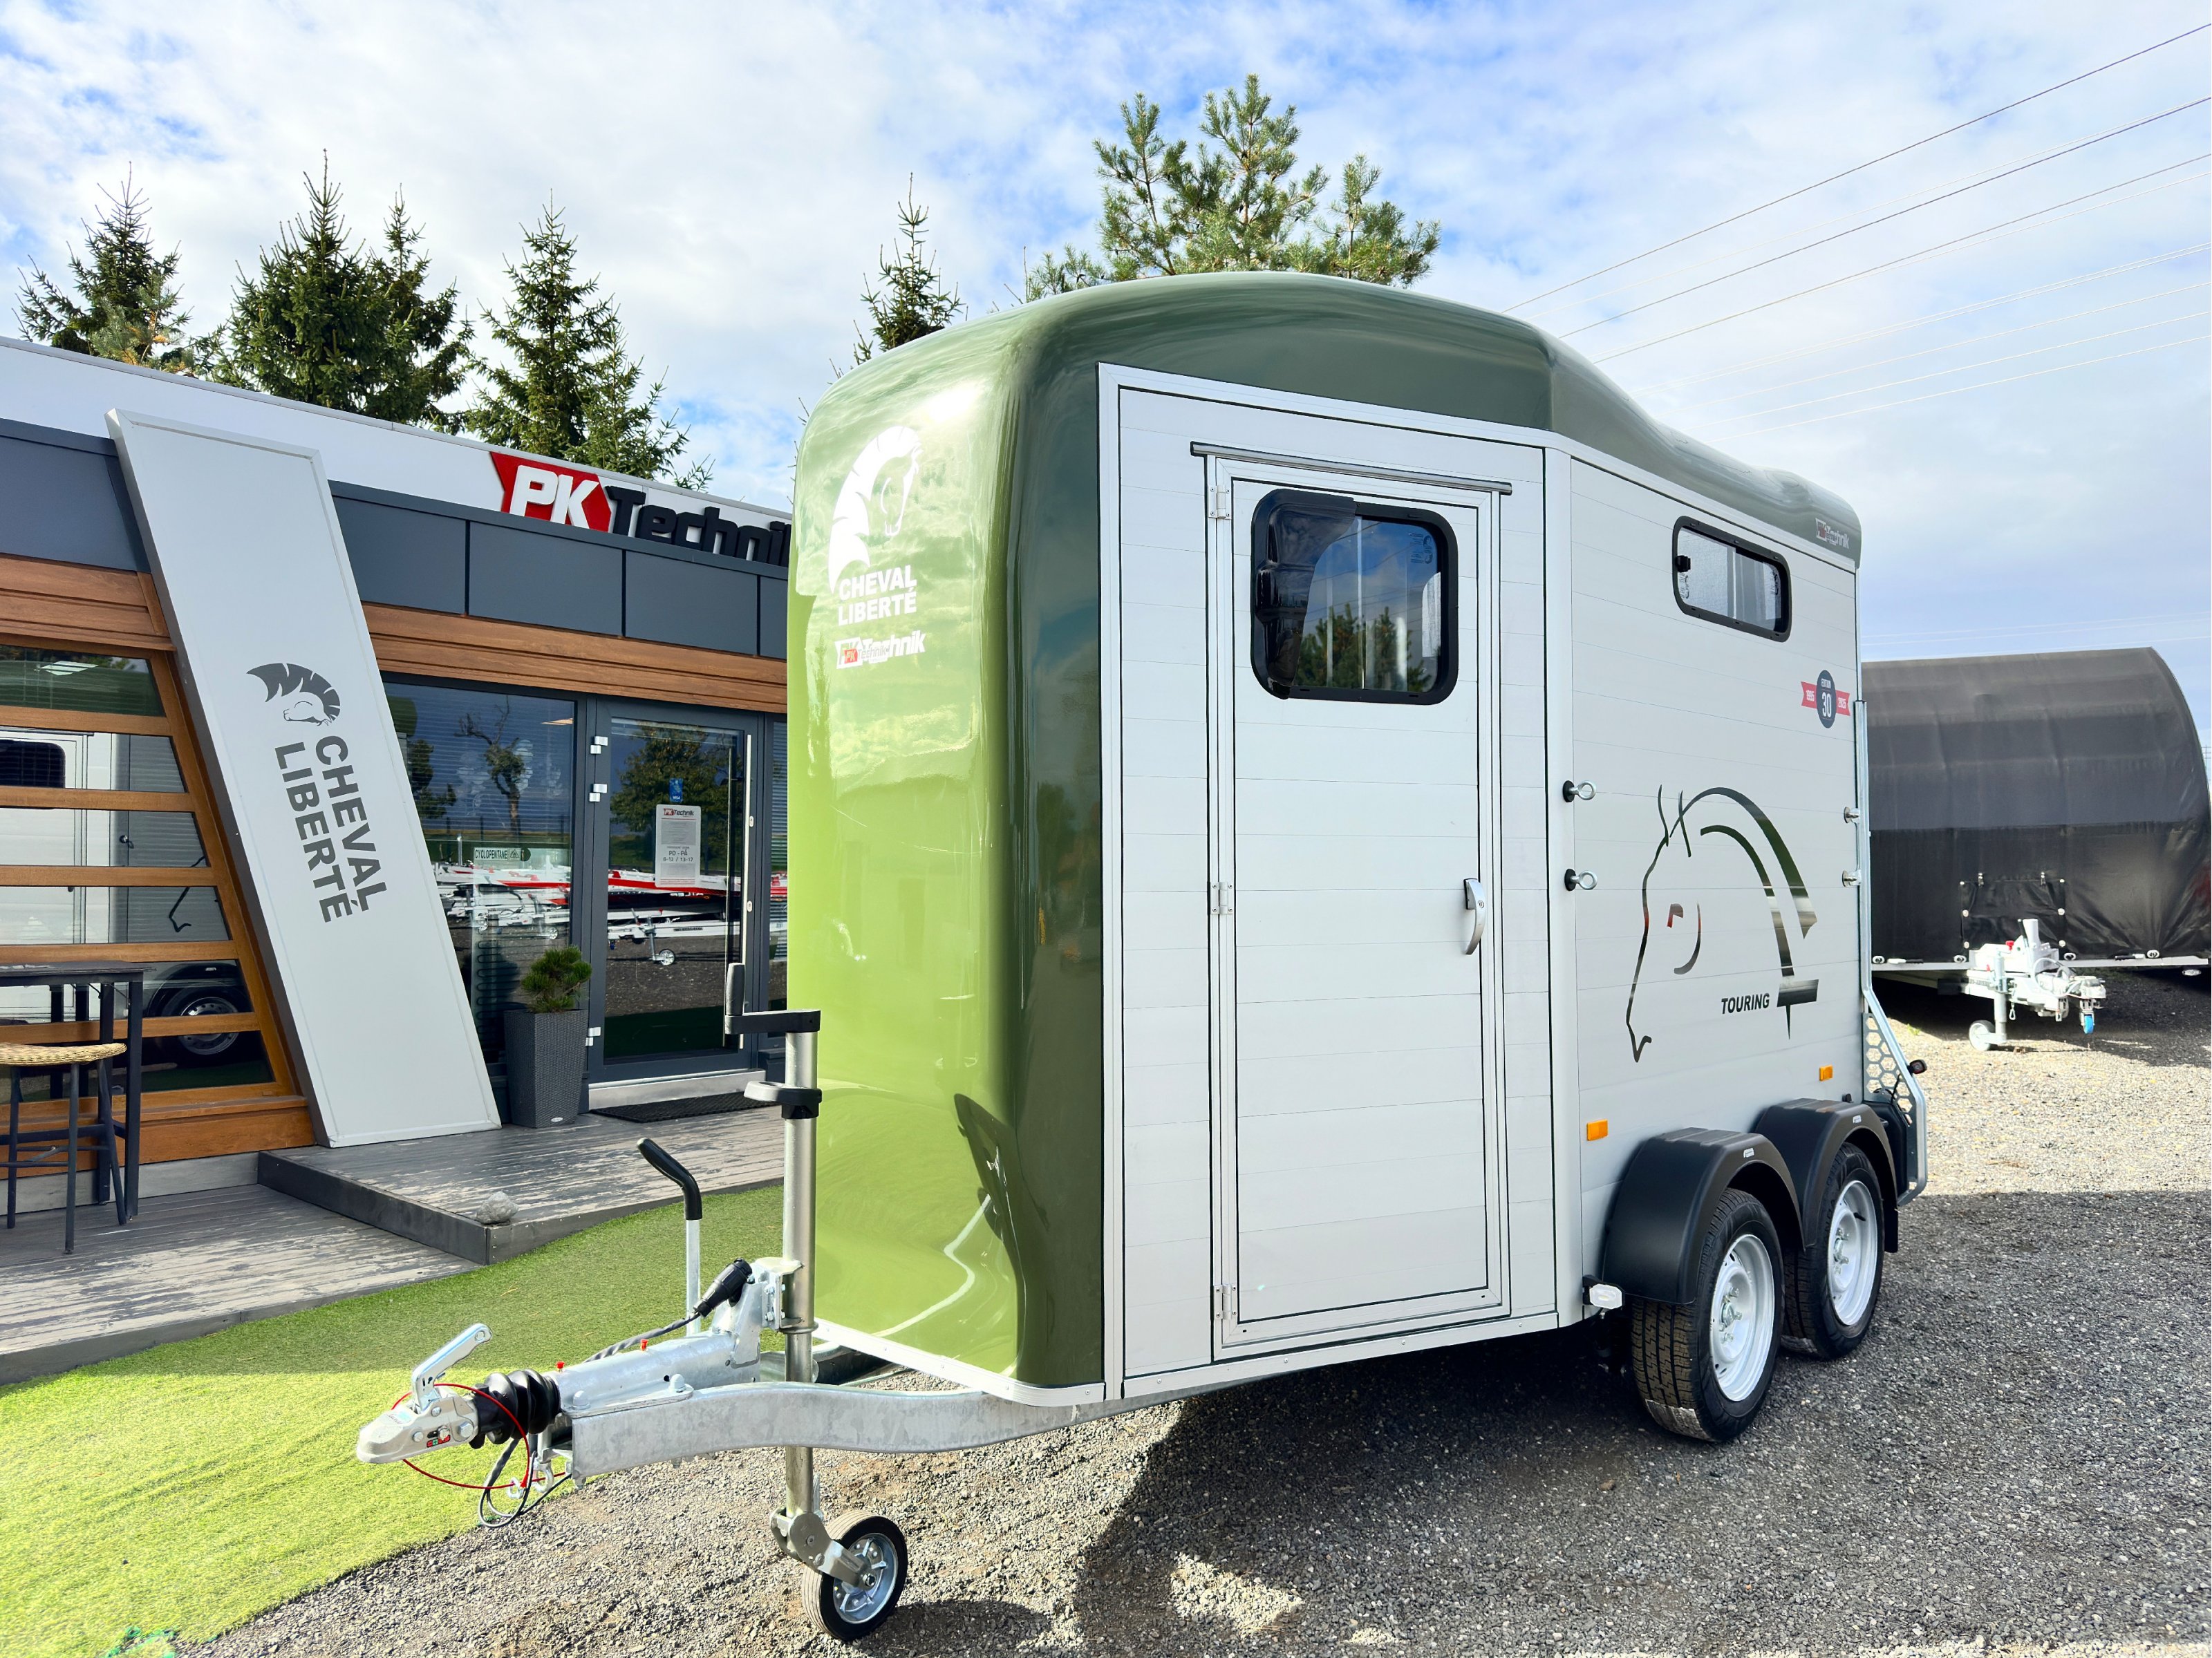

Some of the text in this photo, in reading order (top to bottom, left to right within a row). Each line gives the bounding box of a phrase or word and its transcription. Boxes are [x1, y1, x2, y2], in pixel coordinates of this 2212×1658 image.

[509, 464, 599, 529] PK
[839, 565, 917, 601] CHEVAL
[838, 587, 917, 626] LIBERTÉ
[1821, 692, 1832, 717] 30
[274, 742, 359, 923] LIBERTÉ
[315, 735, 387, 912] CHEVAL
[475, 849, 507, 859] CYCLOPENTANE
[1721, 992, 1770, 1015] TOURING
